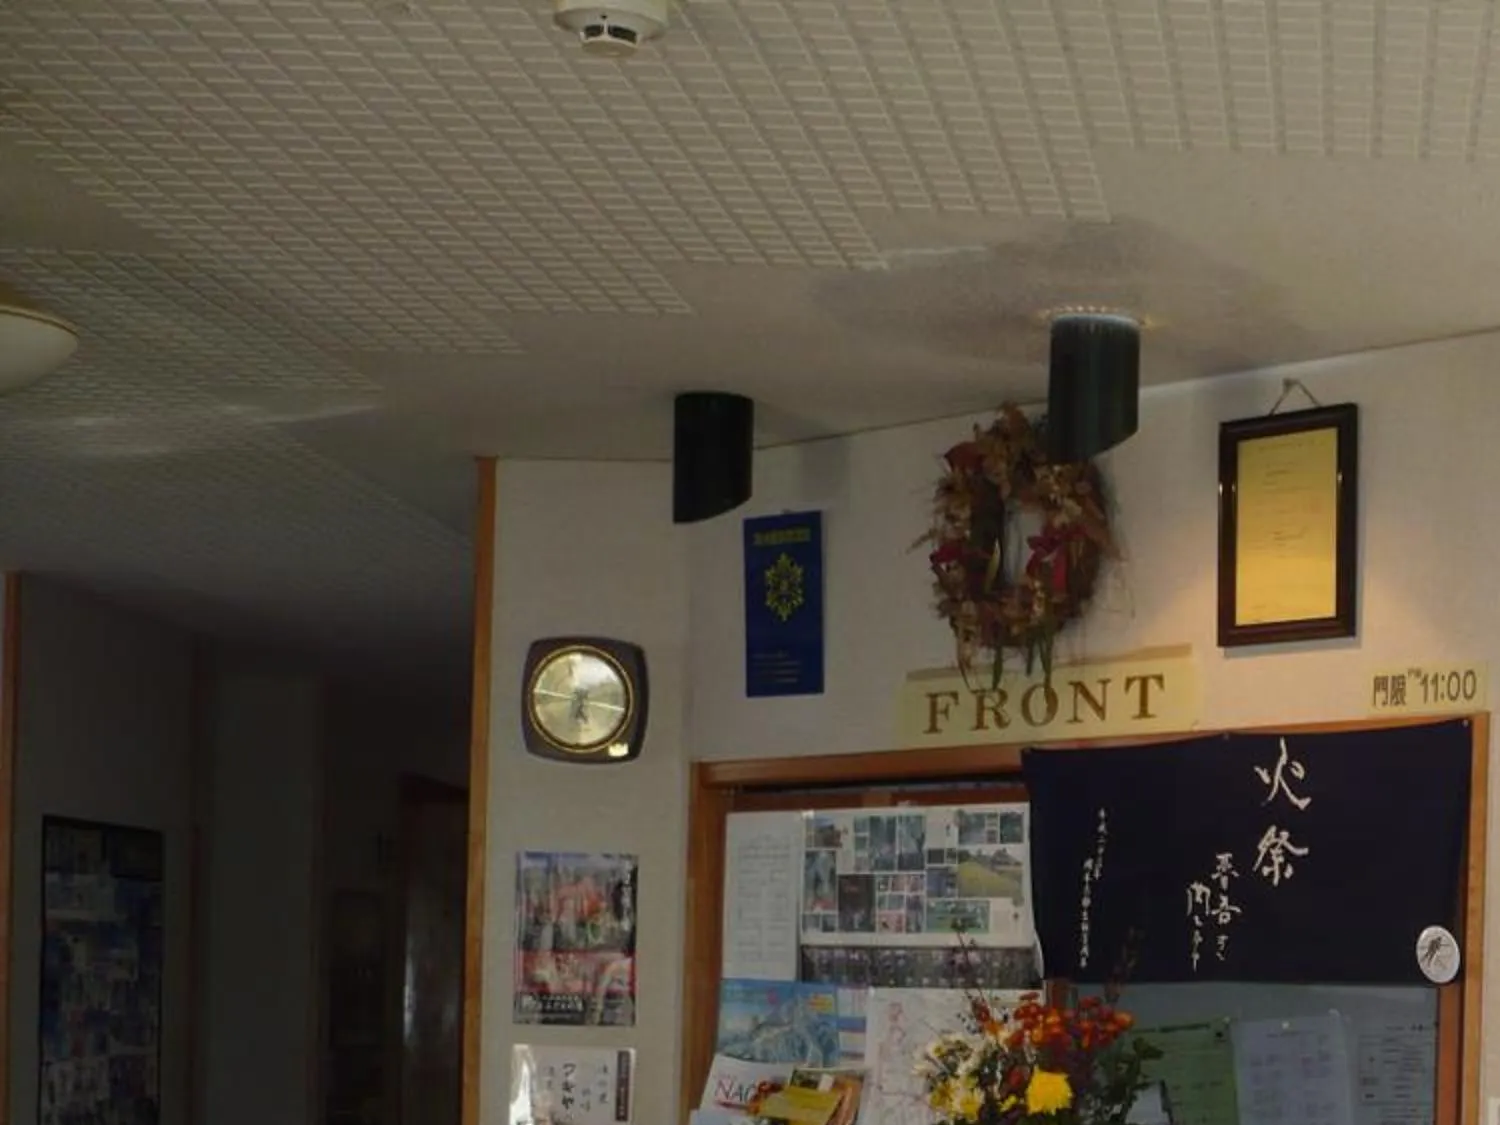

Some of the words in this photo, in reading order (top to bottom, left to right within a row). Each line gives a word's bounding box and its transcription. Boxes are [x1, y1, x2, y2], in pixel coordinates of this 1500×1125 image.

[921, 671, 1166, 735] FRONT
[1372, 674, 1407, 708] 門限
[1420, 669, 1477, 706] 11:00
